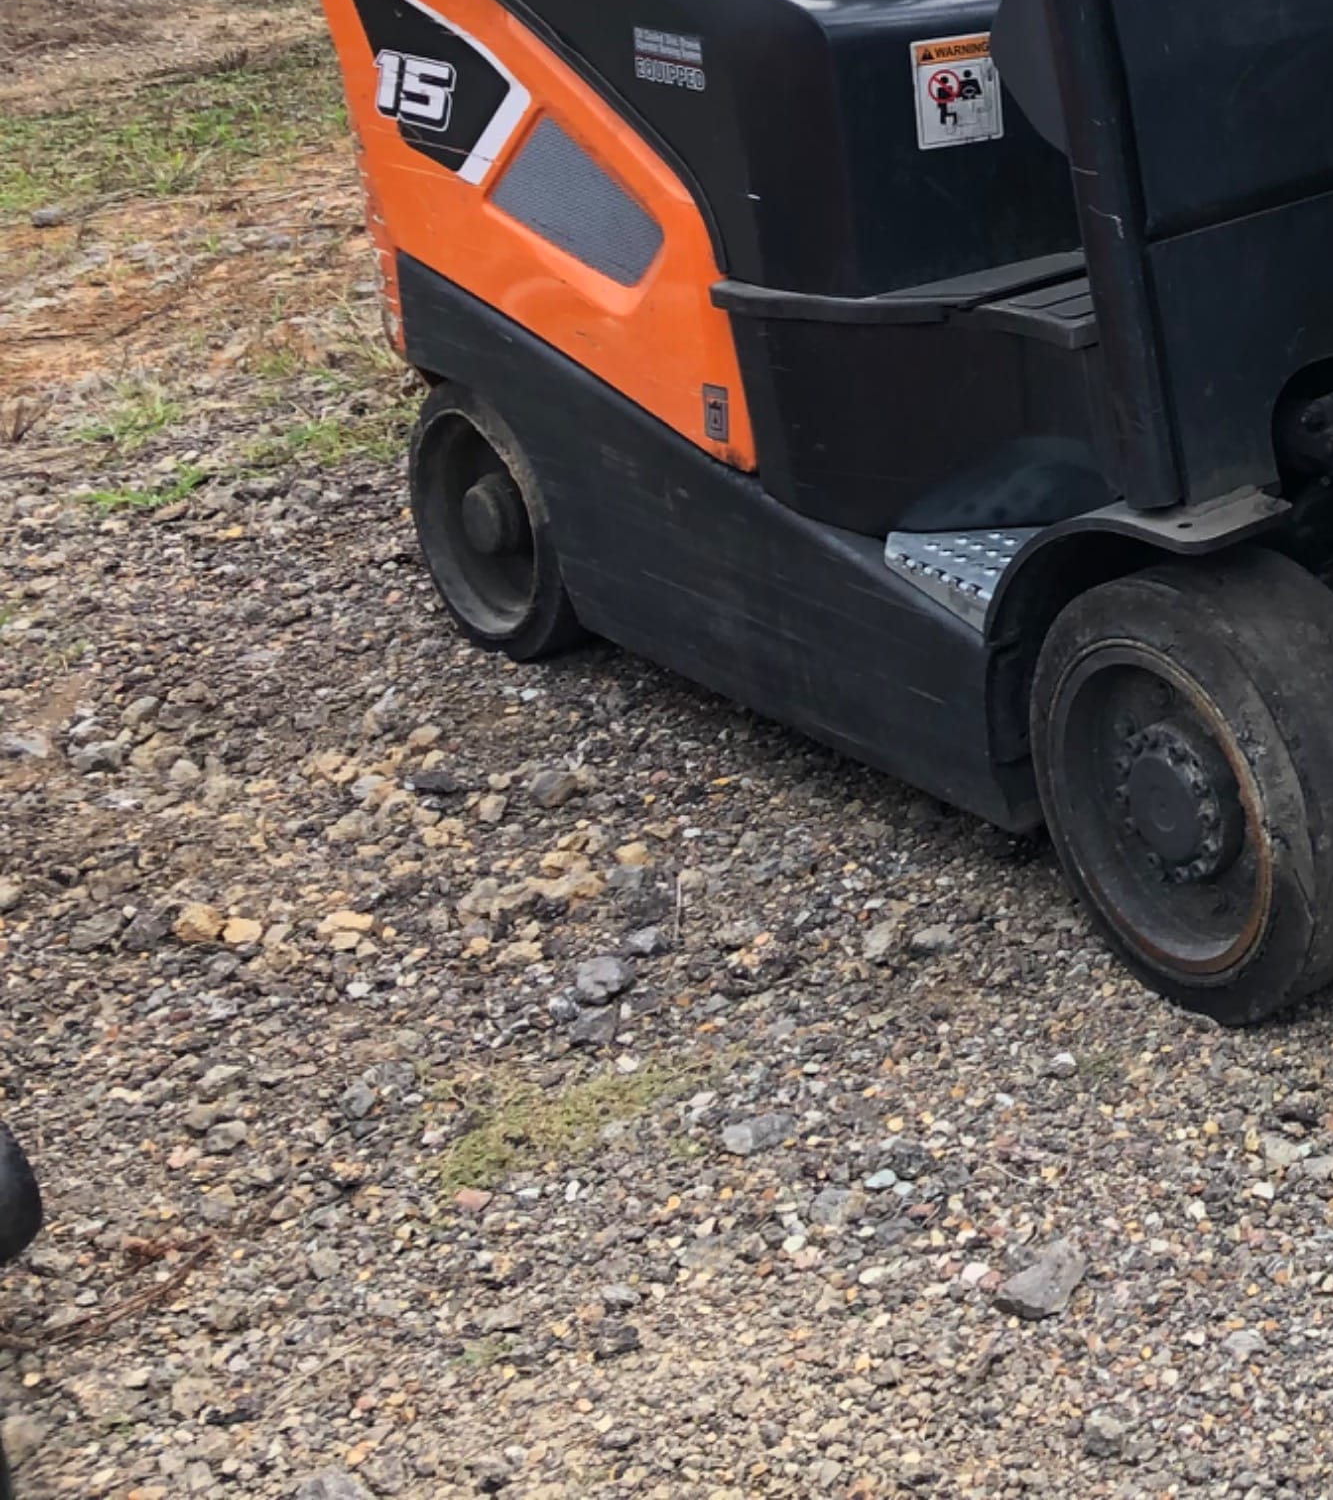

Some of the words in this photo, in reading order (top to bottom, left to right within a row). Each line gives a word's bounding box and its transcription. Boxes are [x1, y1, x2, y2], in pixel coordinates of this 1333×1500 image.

[934, 40, 990, 58] WARNING
[373, 48, 457, 132] 15
[634, 56, 706, 92] EQUIPPED
